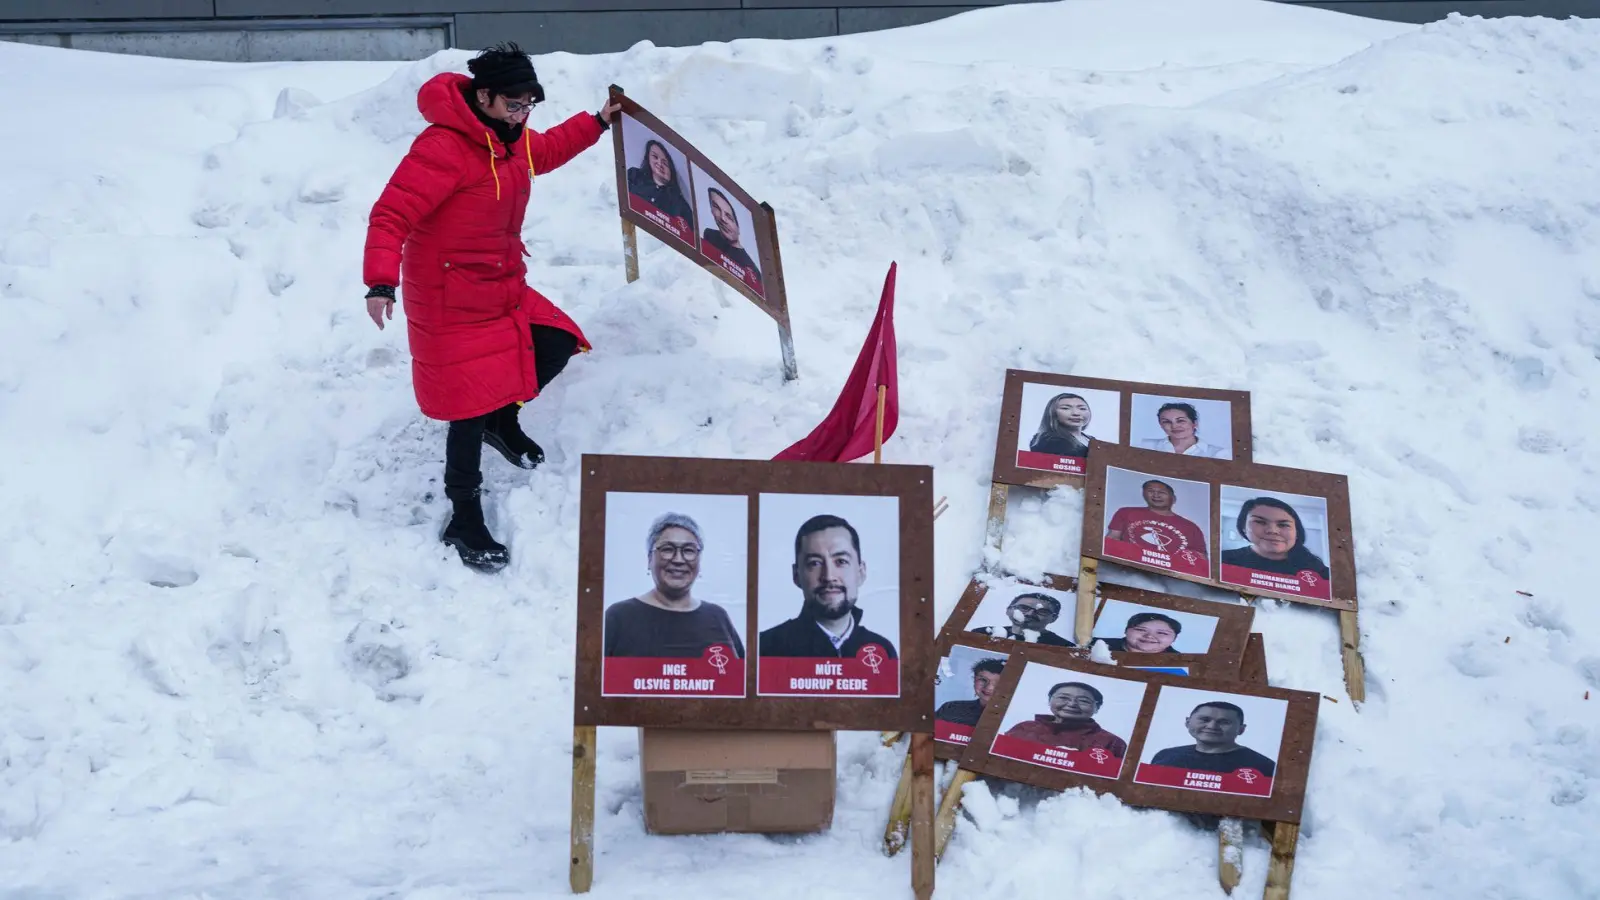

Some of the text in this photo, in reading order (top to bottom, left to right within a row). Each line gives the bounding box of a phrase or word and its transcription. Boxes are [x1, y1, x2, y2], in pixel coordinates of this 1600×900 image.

[1142, 548, 1171, 561] TOBIAS
[1141, 556, 1171, 568] BIANCO
[1275, 582, 1301, 592] BIANCO
[662, 663, 687, 676] INGE
[815, 660, 843, 675] MÚTE
[633, 678, 715, 691] OLSVIG BRANDT
[790, 677, 868, 690] BOURUP EGEDE
[1044, 748, 1069, 759] MIMI
[1032, 753, 1075, 768] KARLSEN
[1186, 771, 1223, 782] LUDVIG
[1183, 779, 1222, 790] LARSEN
